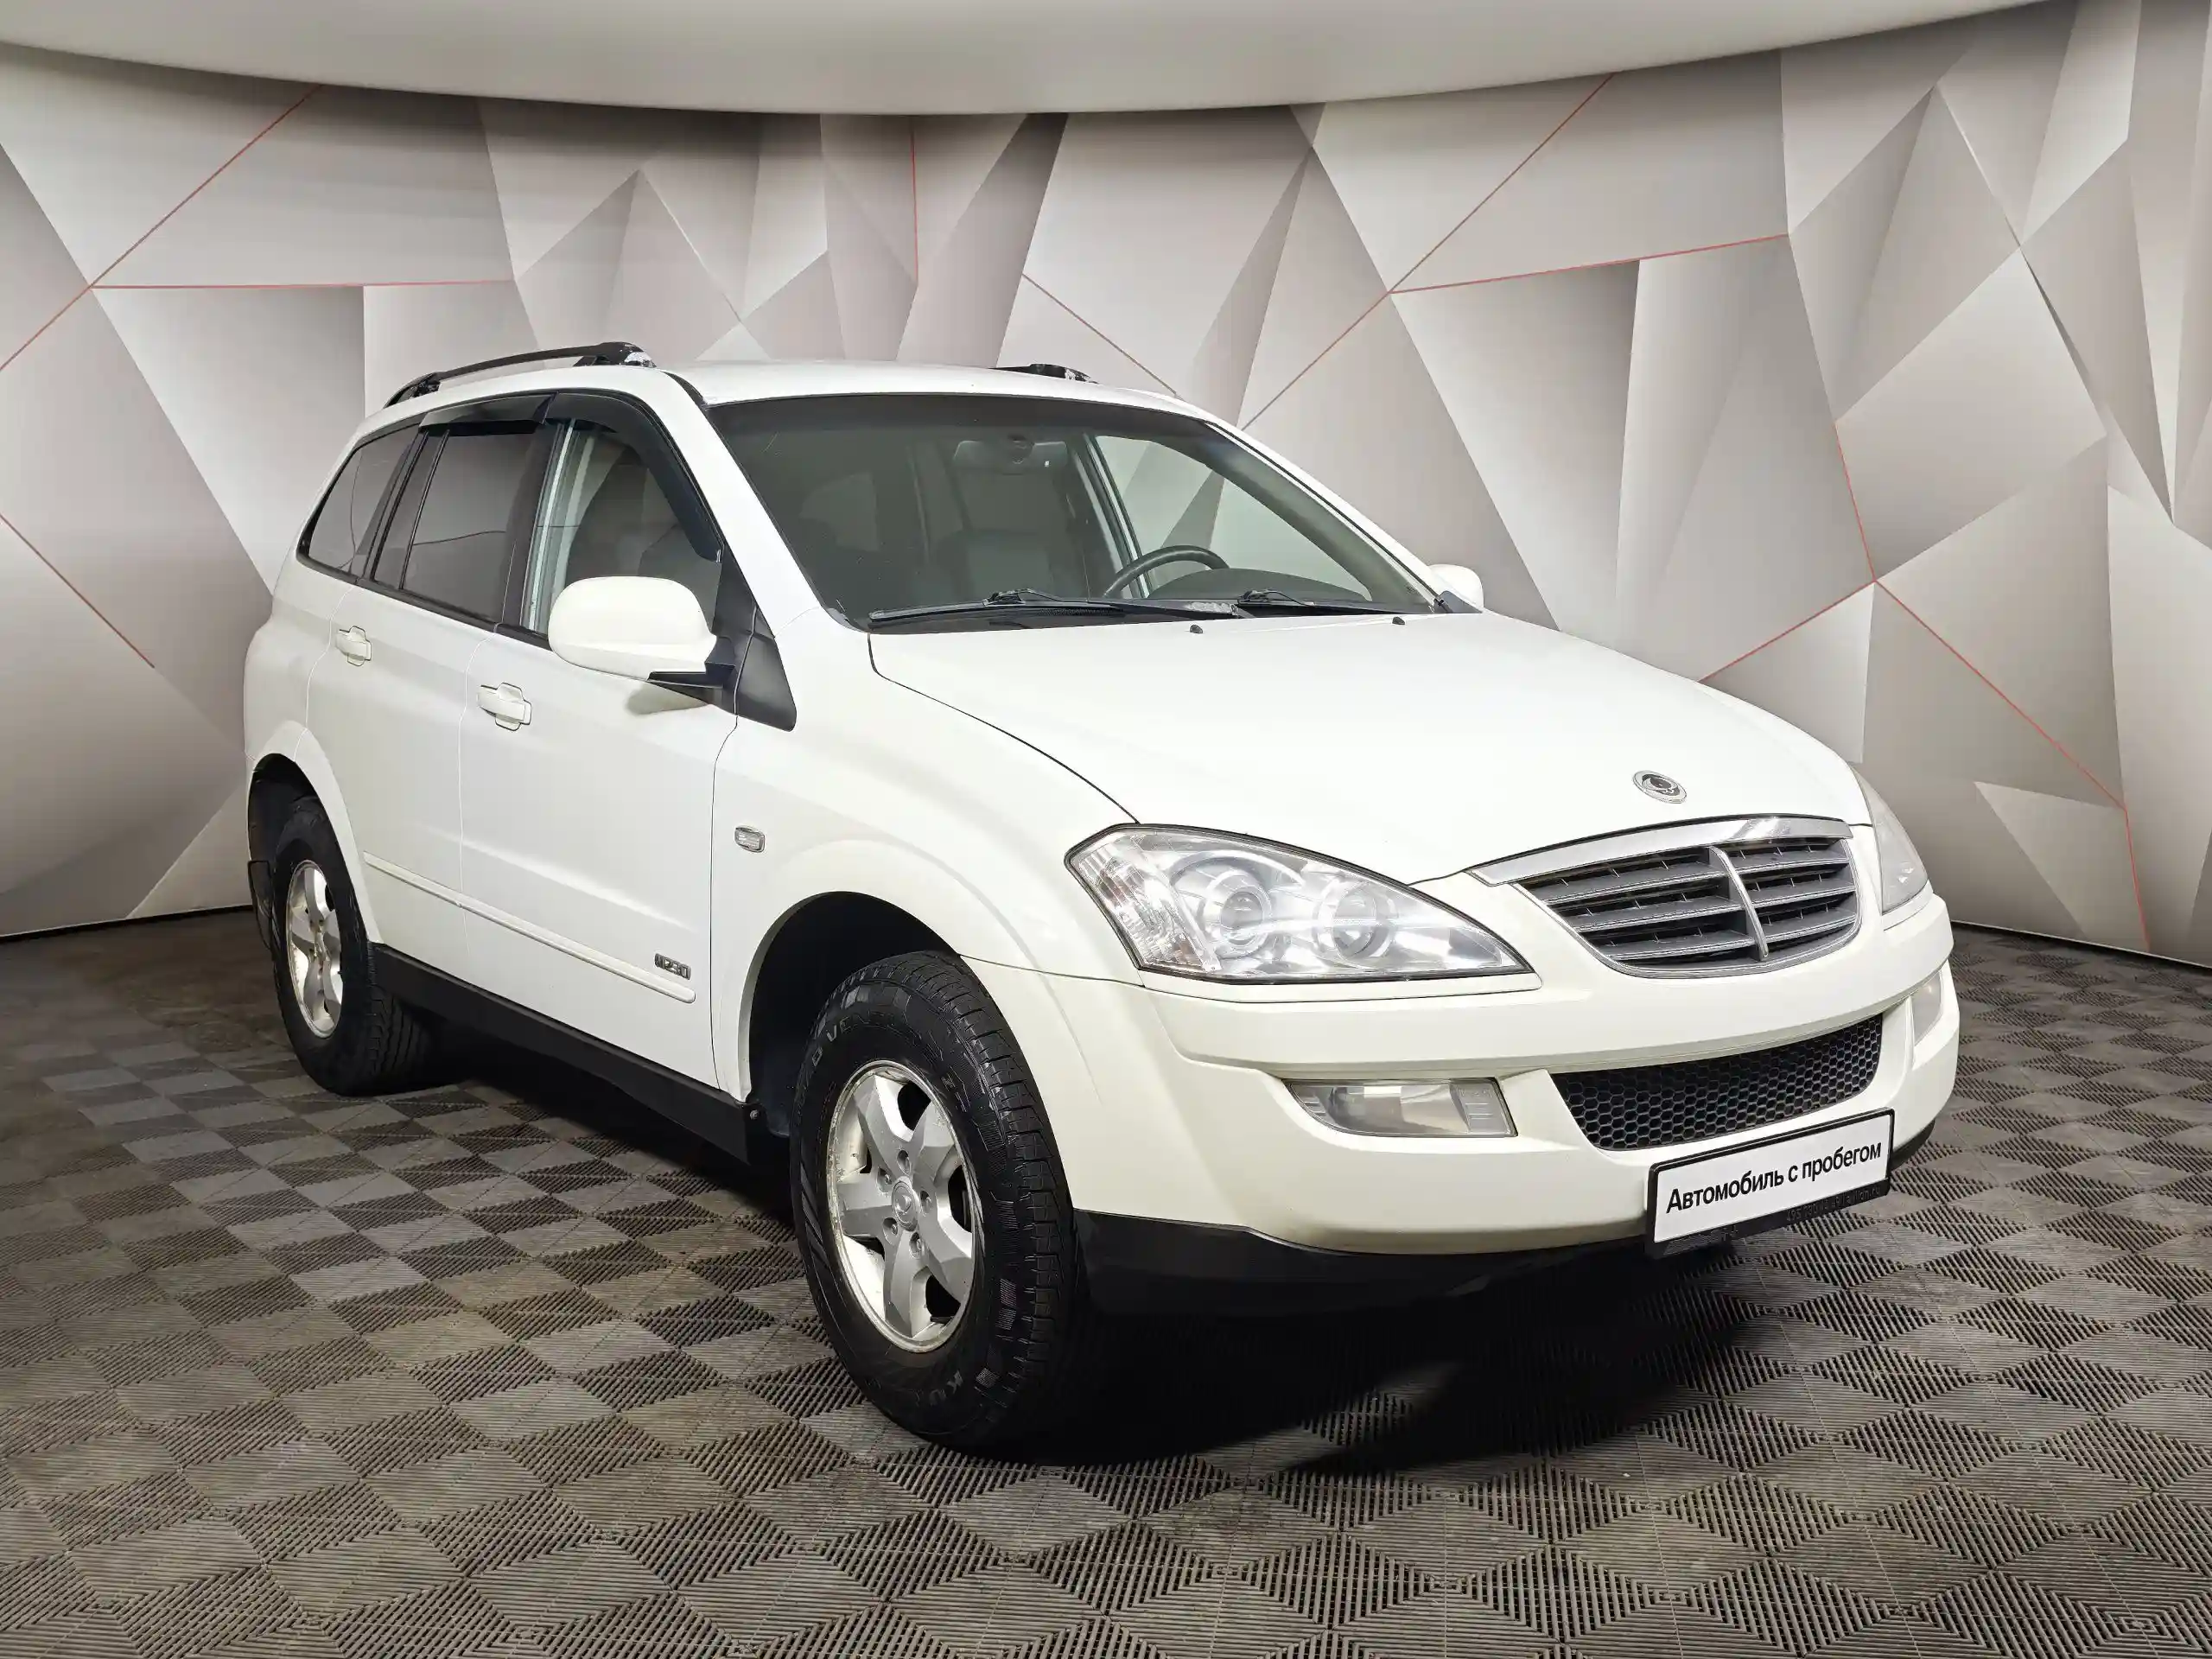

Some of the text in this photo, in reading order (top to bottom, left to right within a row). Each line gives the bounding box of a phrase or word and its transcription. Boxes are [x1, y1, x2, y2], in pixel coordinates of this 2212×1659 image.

[1667, 1171, 1783, 1213] Автомобиль
[1788, 1166, 1798, 1182] с
[1802, 1142, 1881, 1181] пробегом
